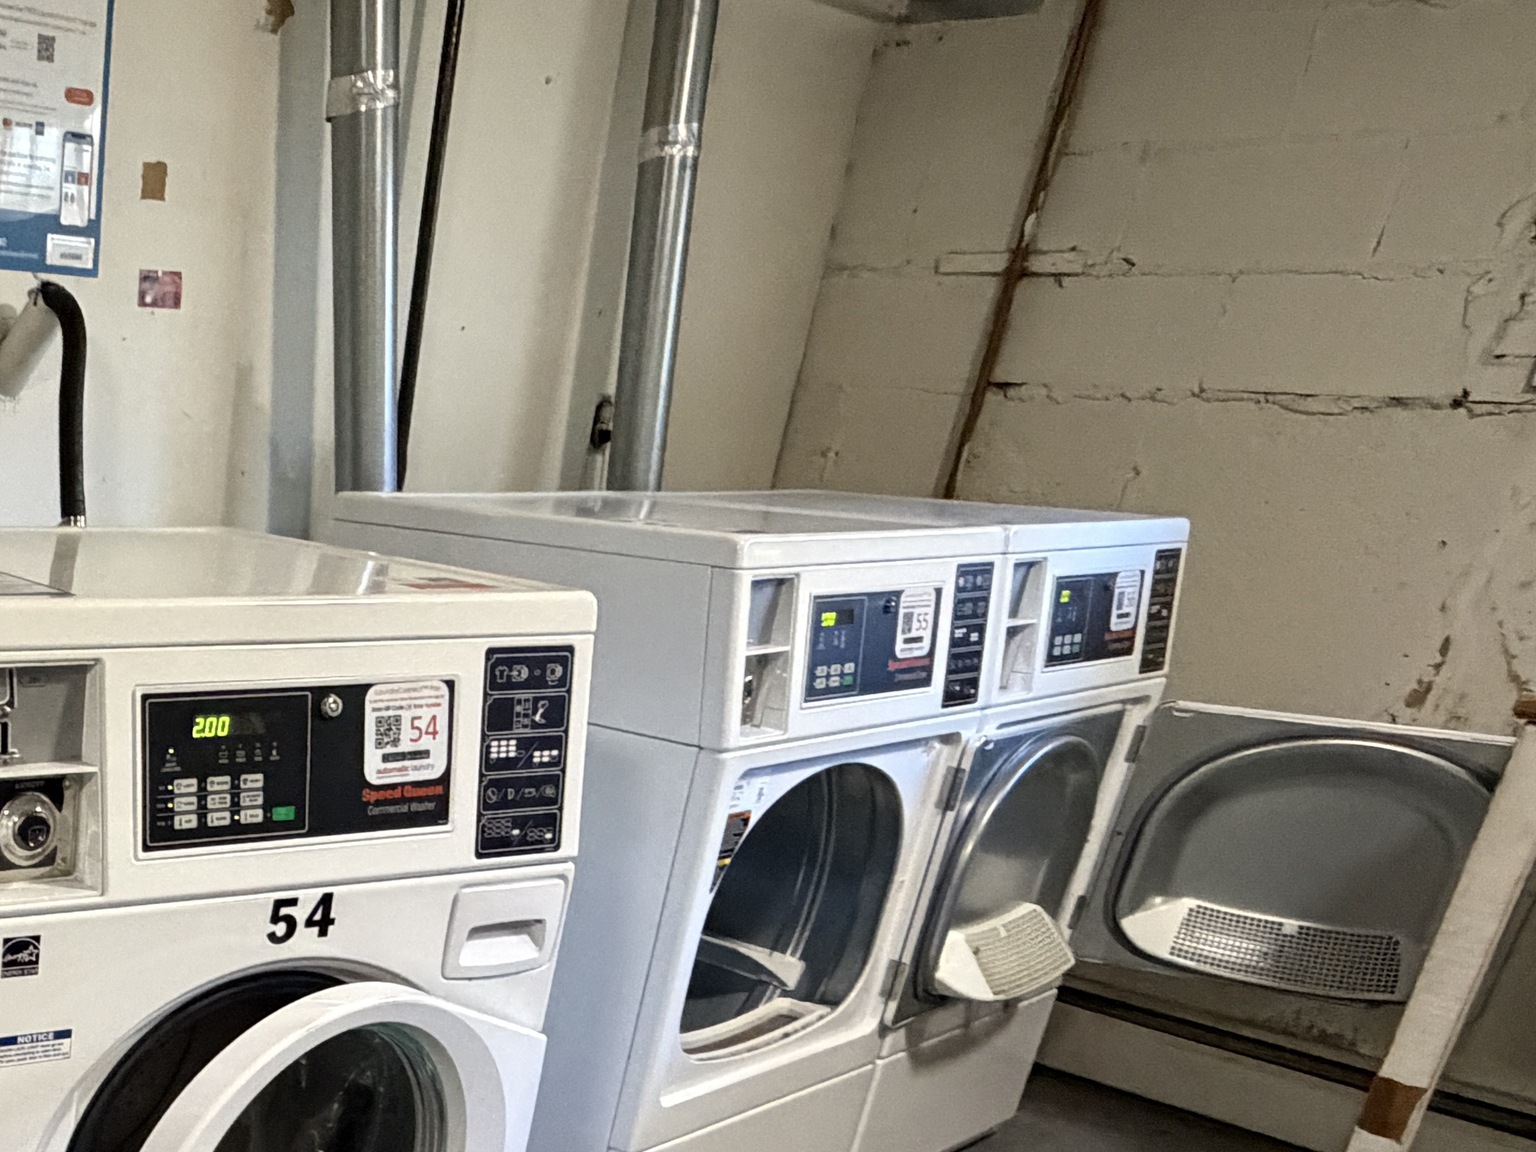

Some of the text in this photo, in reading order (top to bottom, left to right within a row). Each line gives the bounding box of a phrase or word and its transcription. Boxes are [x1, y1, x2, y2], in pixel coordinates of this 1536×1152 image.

[409, 714, 439, 742] 54
[266, 892, 336, 945] 54
[17, 1032, 54, 1044] NOTICE
